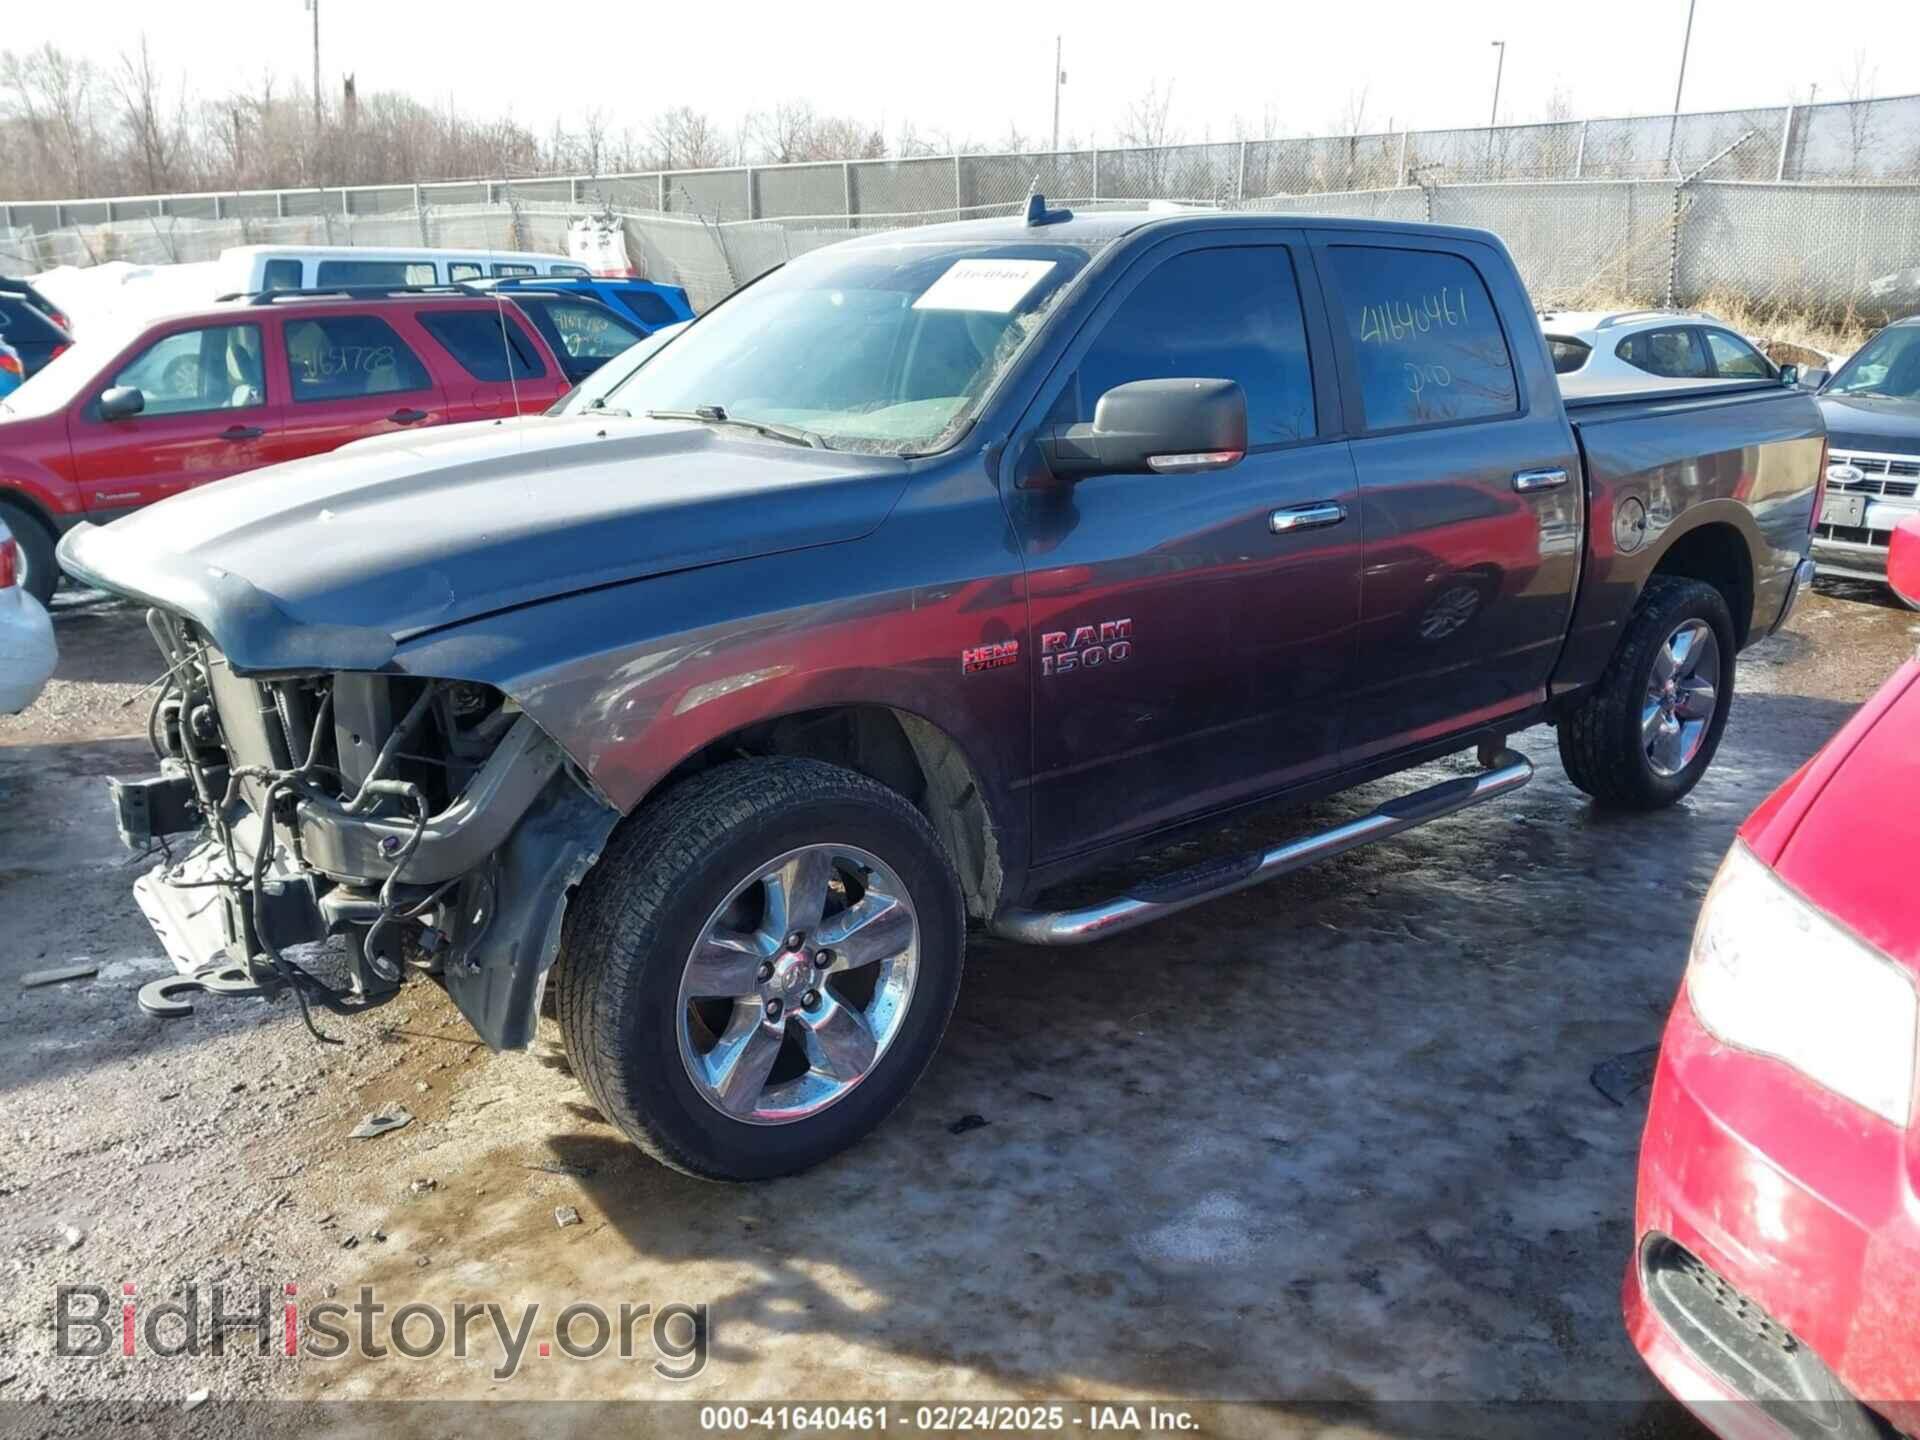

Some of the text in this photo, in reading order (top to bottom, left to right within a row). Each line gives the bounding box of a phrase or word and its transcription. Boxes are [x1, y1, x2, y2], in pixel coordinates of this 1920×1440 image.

[1360, 286, 1469, 346] 41640461
[1041, 618, 1132, 653] RAM
[1041, 641, 1133, 677] 1500
